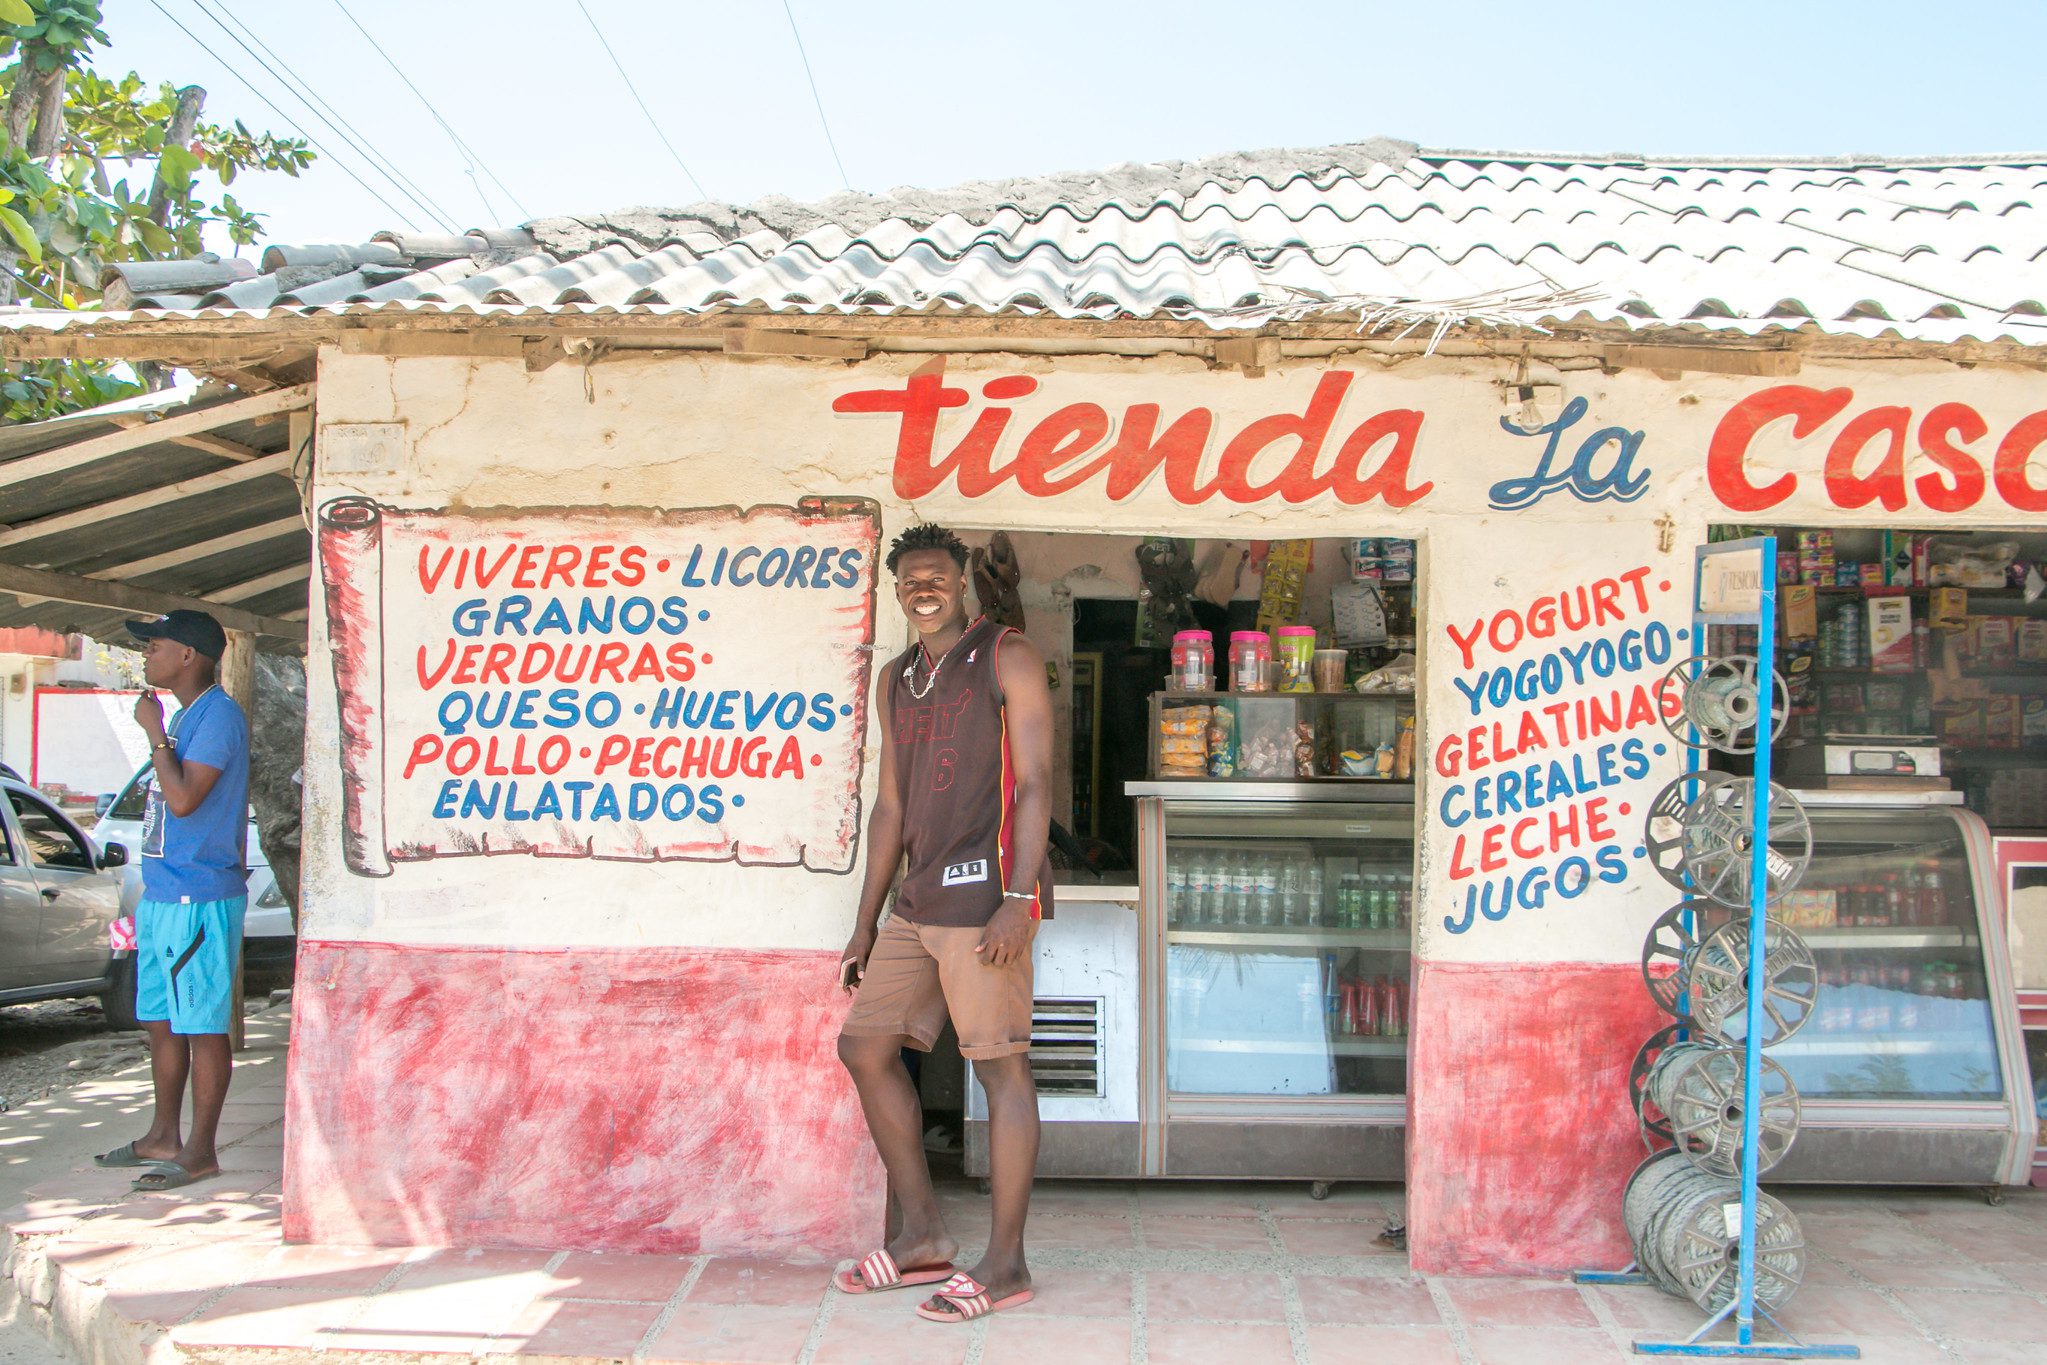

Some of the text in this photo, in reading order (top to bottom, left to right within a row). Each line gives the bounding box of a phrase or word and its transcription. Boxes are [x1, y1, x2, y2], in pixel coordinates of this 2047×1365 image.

[832, 355, 1434, 507] tienda
[1489, 396, 1650, 511] La
[418, 543, 860, 594] VIVERES LICORES
[452, 595, 689, 637] GRANOS
[1445, 566, 1652, 670] YOGURT
[417, 639, 696, 691] VERDURAS
[1453, 621, 1671, 716] YOGOYOGO
[438, 687, 837, 737] QUESO HUEVOS
[1435, 677, 1683, 778] GELATINAS
[403, 734, 805, 780] POLLO PECHUGA
[931, 748, 958, 791] 6
[1440, 737, 1650, 828] CEREALES
[432, 779, 725, 824] ENLATADOS
[1449, 796, 1616, 881] LECHE
[1443, 845, 1628, 935] JUGOS
